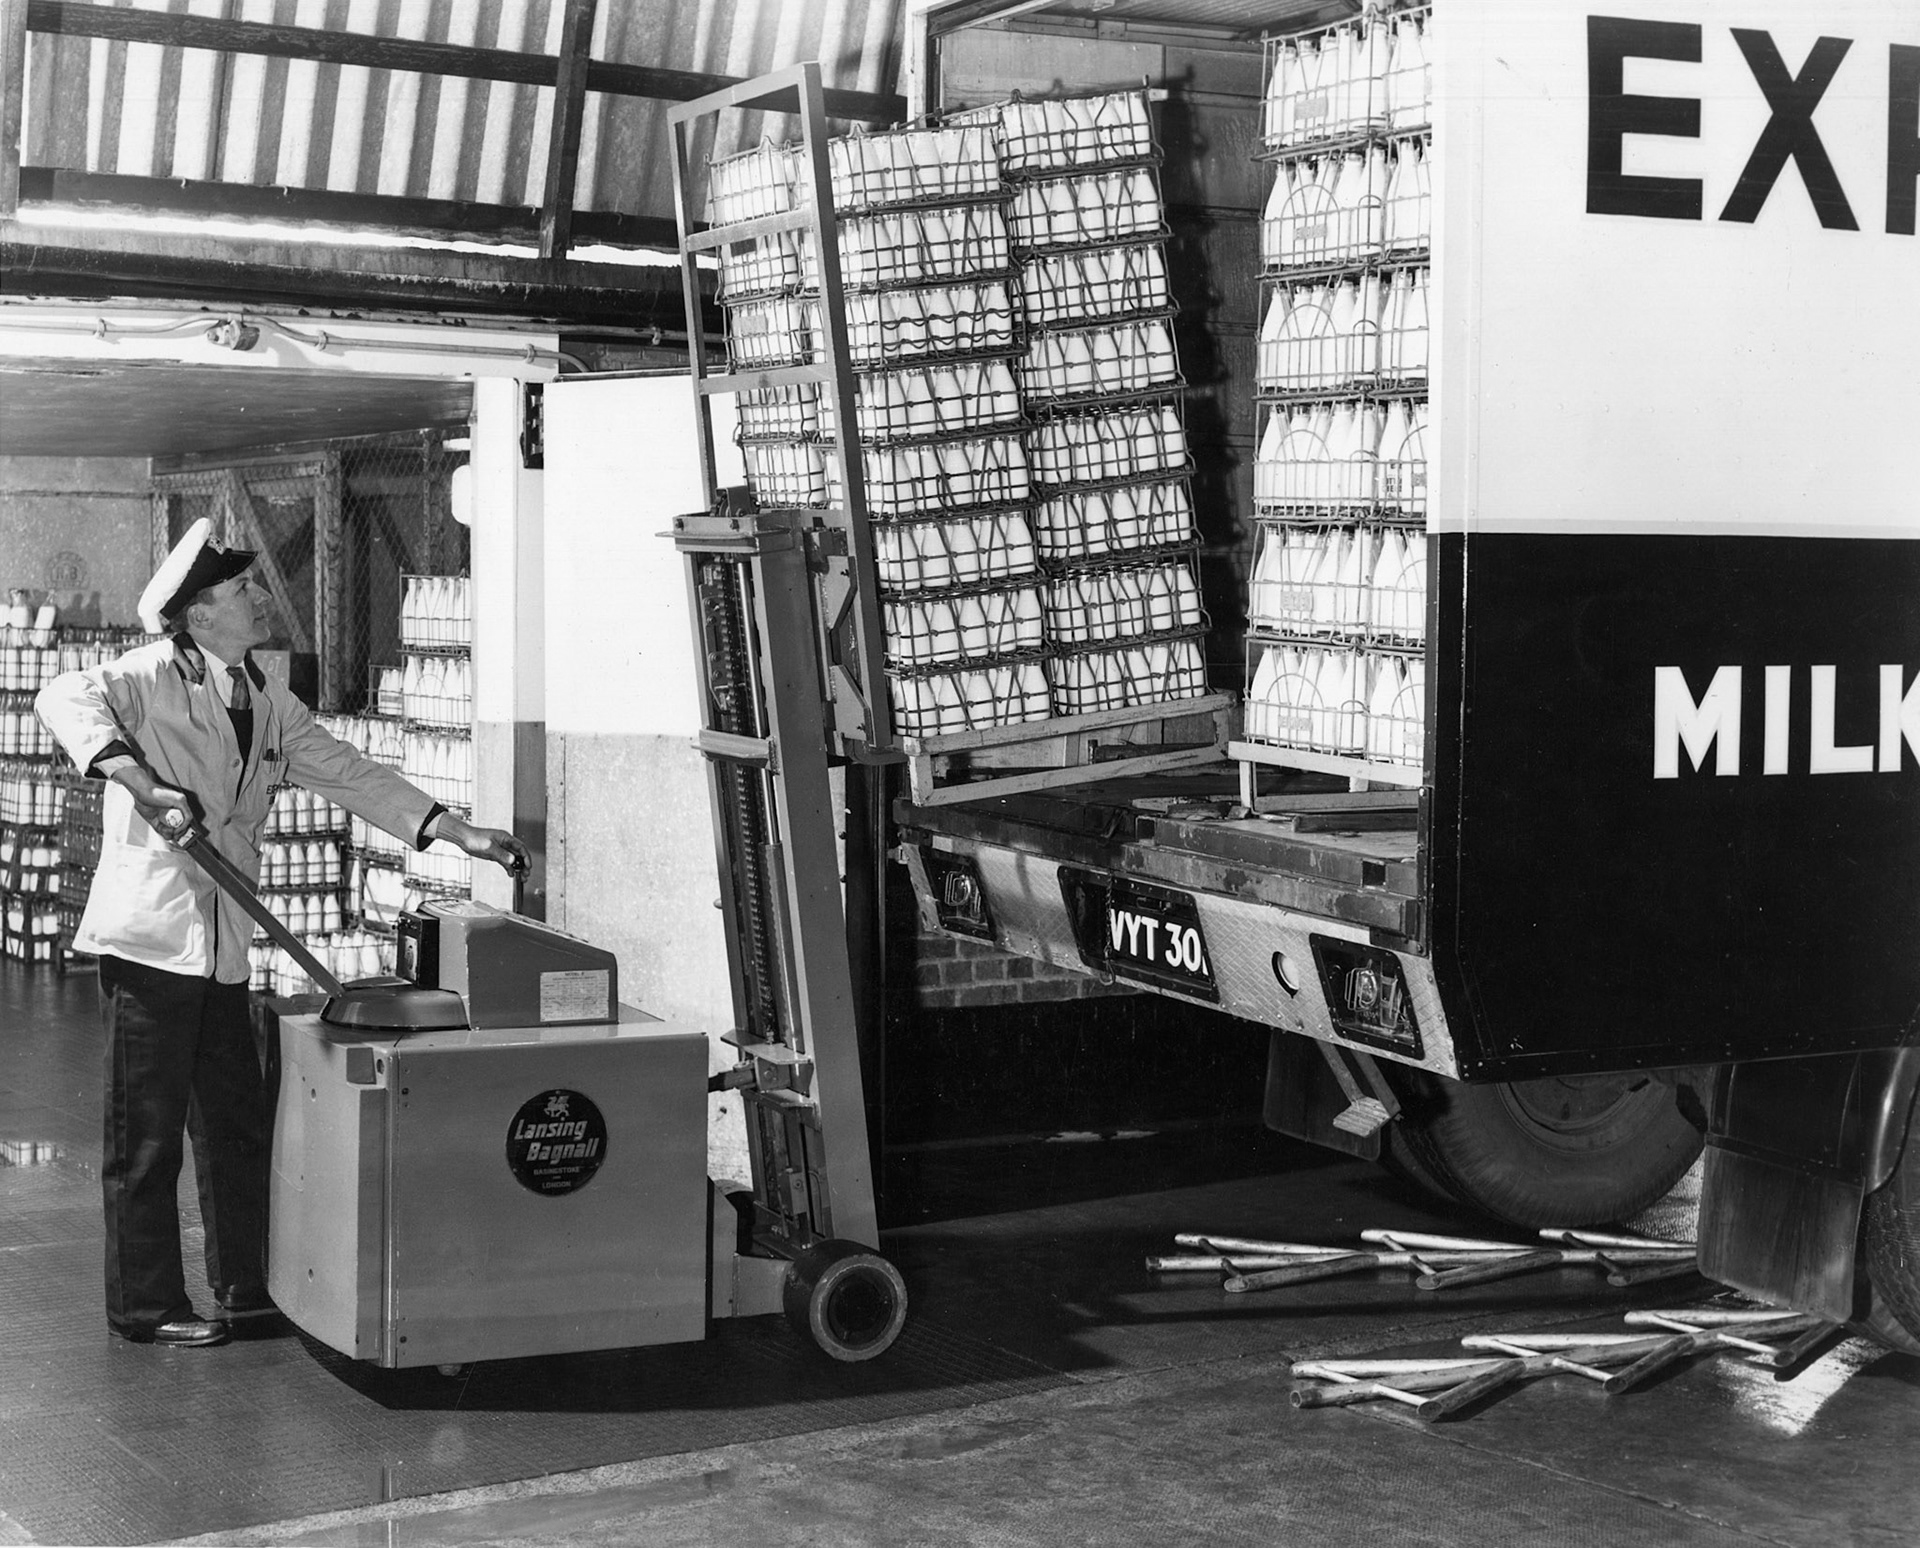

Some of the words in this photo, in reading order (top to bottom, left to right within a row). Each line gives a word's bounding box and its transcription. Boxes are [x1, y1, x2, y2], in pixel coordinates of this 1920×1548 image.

[1654, 664, 1920, 779] MILK
[1110, 908, 1159, 961] VYT
[1165, 922, 1209, 976] 30
[514, 1117, 588, 1142] Lansing
[526, 1138, 600, 1165] Bagnall
[533, 1166, 580, 1176] BASINGSTOKE
[542, 1181, 572, 1190] LONDON
